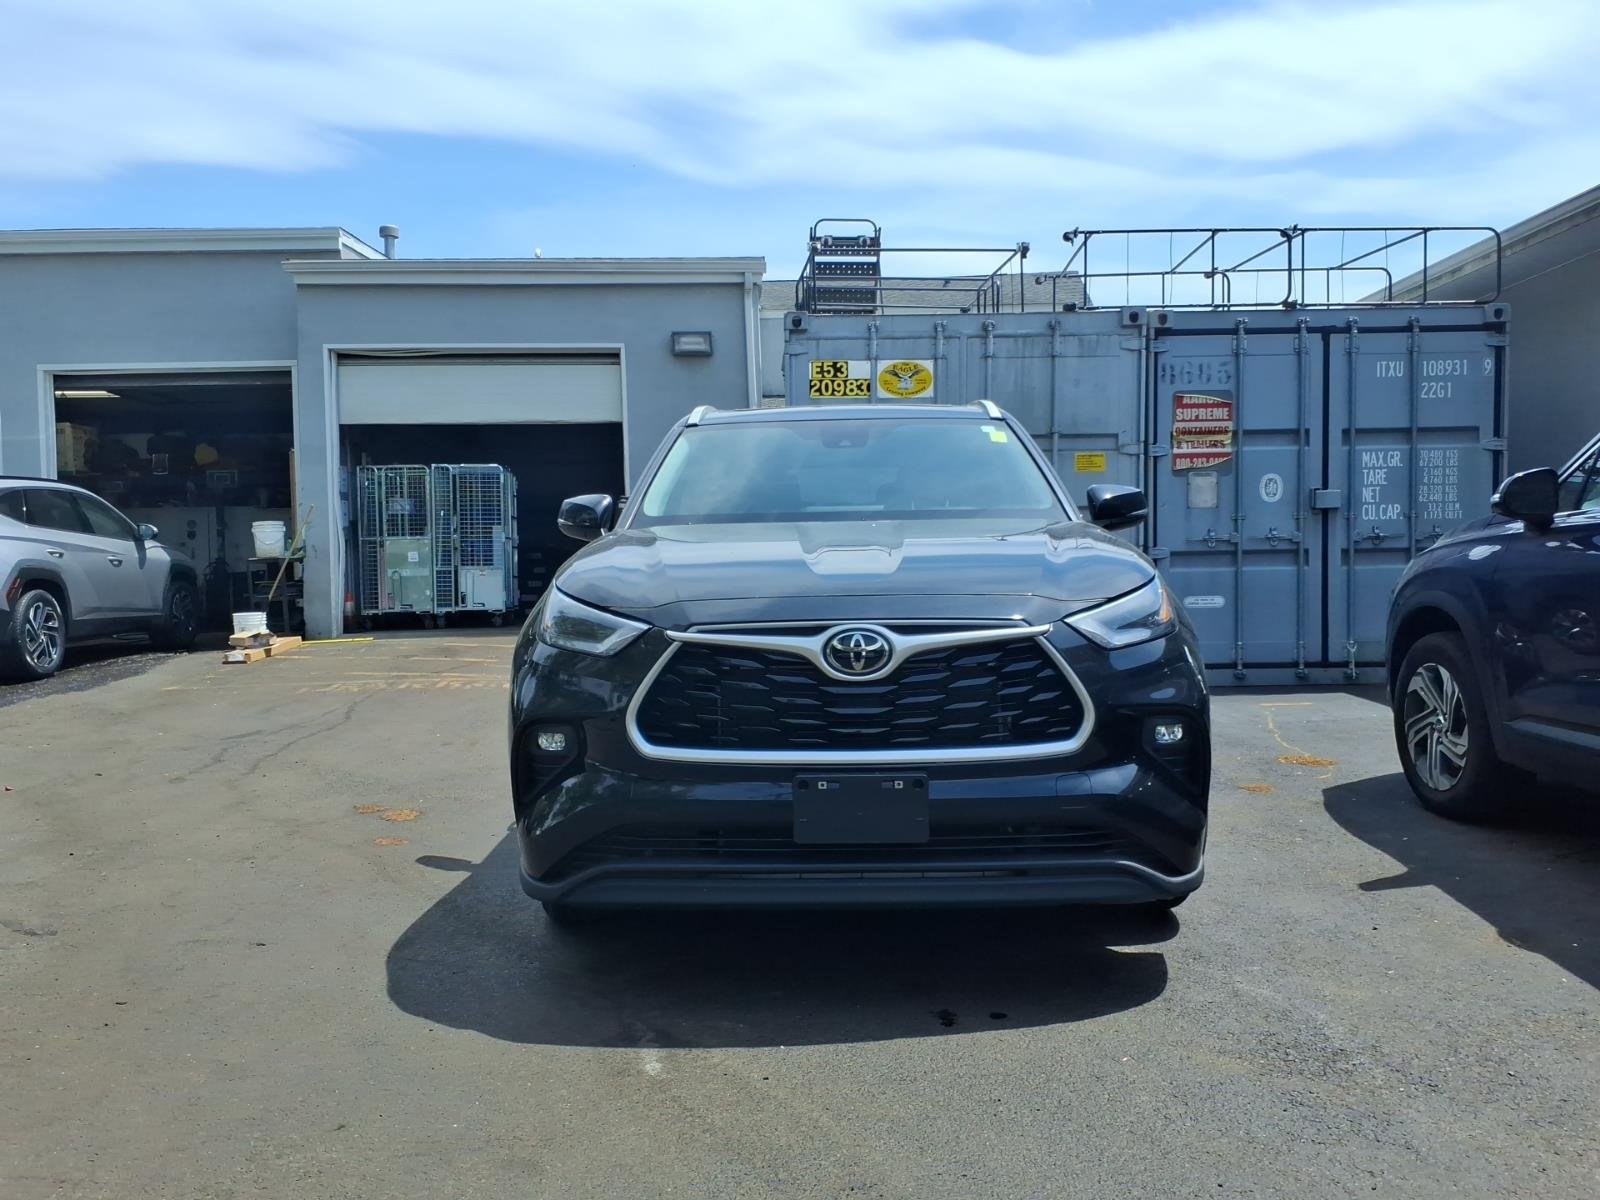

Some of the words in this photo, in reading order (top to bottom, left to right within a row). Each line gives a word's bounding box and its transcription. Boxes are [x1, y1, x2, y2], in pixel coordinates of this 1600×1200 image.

[812, 362, 848, 378] E53
[892, 364, 920, 373] EAGLE
[1376, 361, 1404, 378] ITXU
[1422, 359, 1468, 377] 108931
[1484, 359, 1492, 376] 9
[1420, 382, 1452, 398] 22G1
[1175, 407, 1230, 421] SUPREME
[1362, 469, 1389, 485] TARE
[1362, 486, 1381, 502] NET
